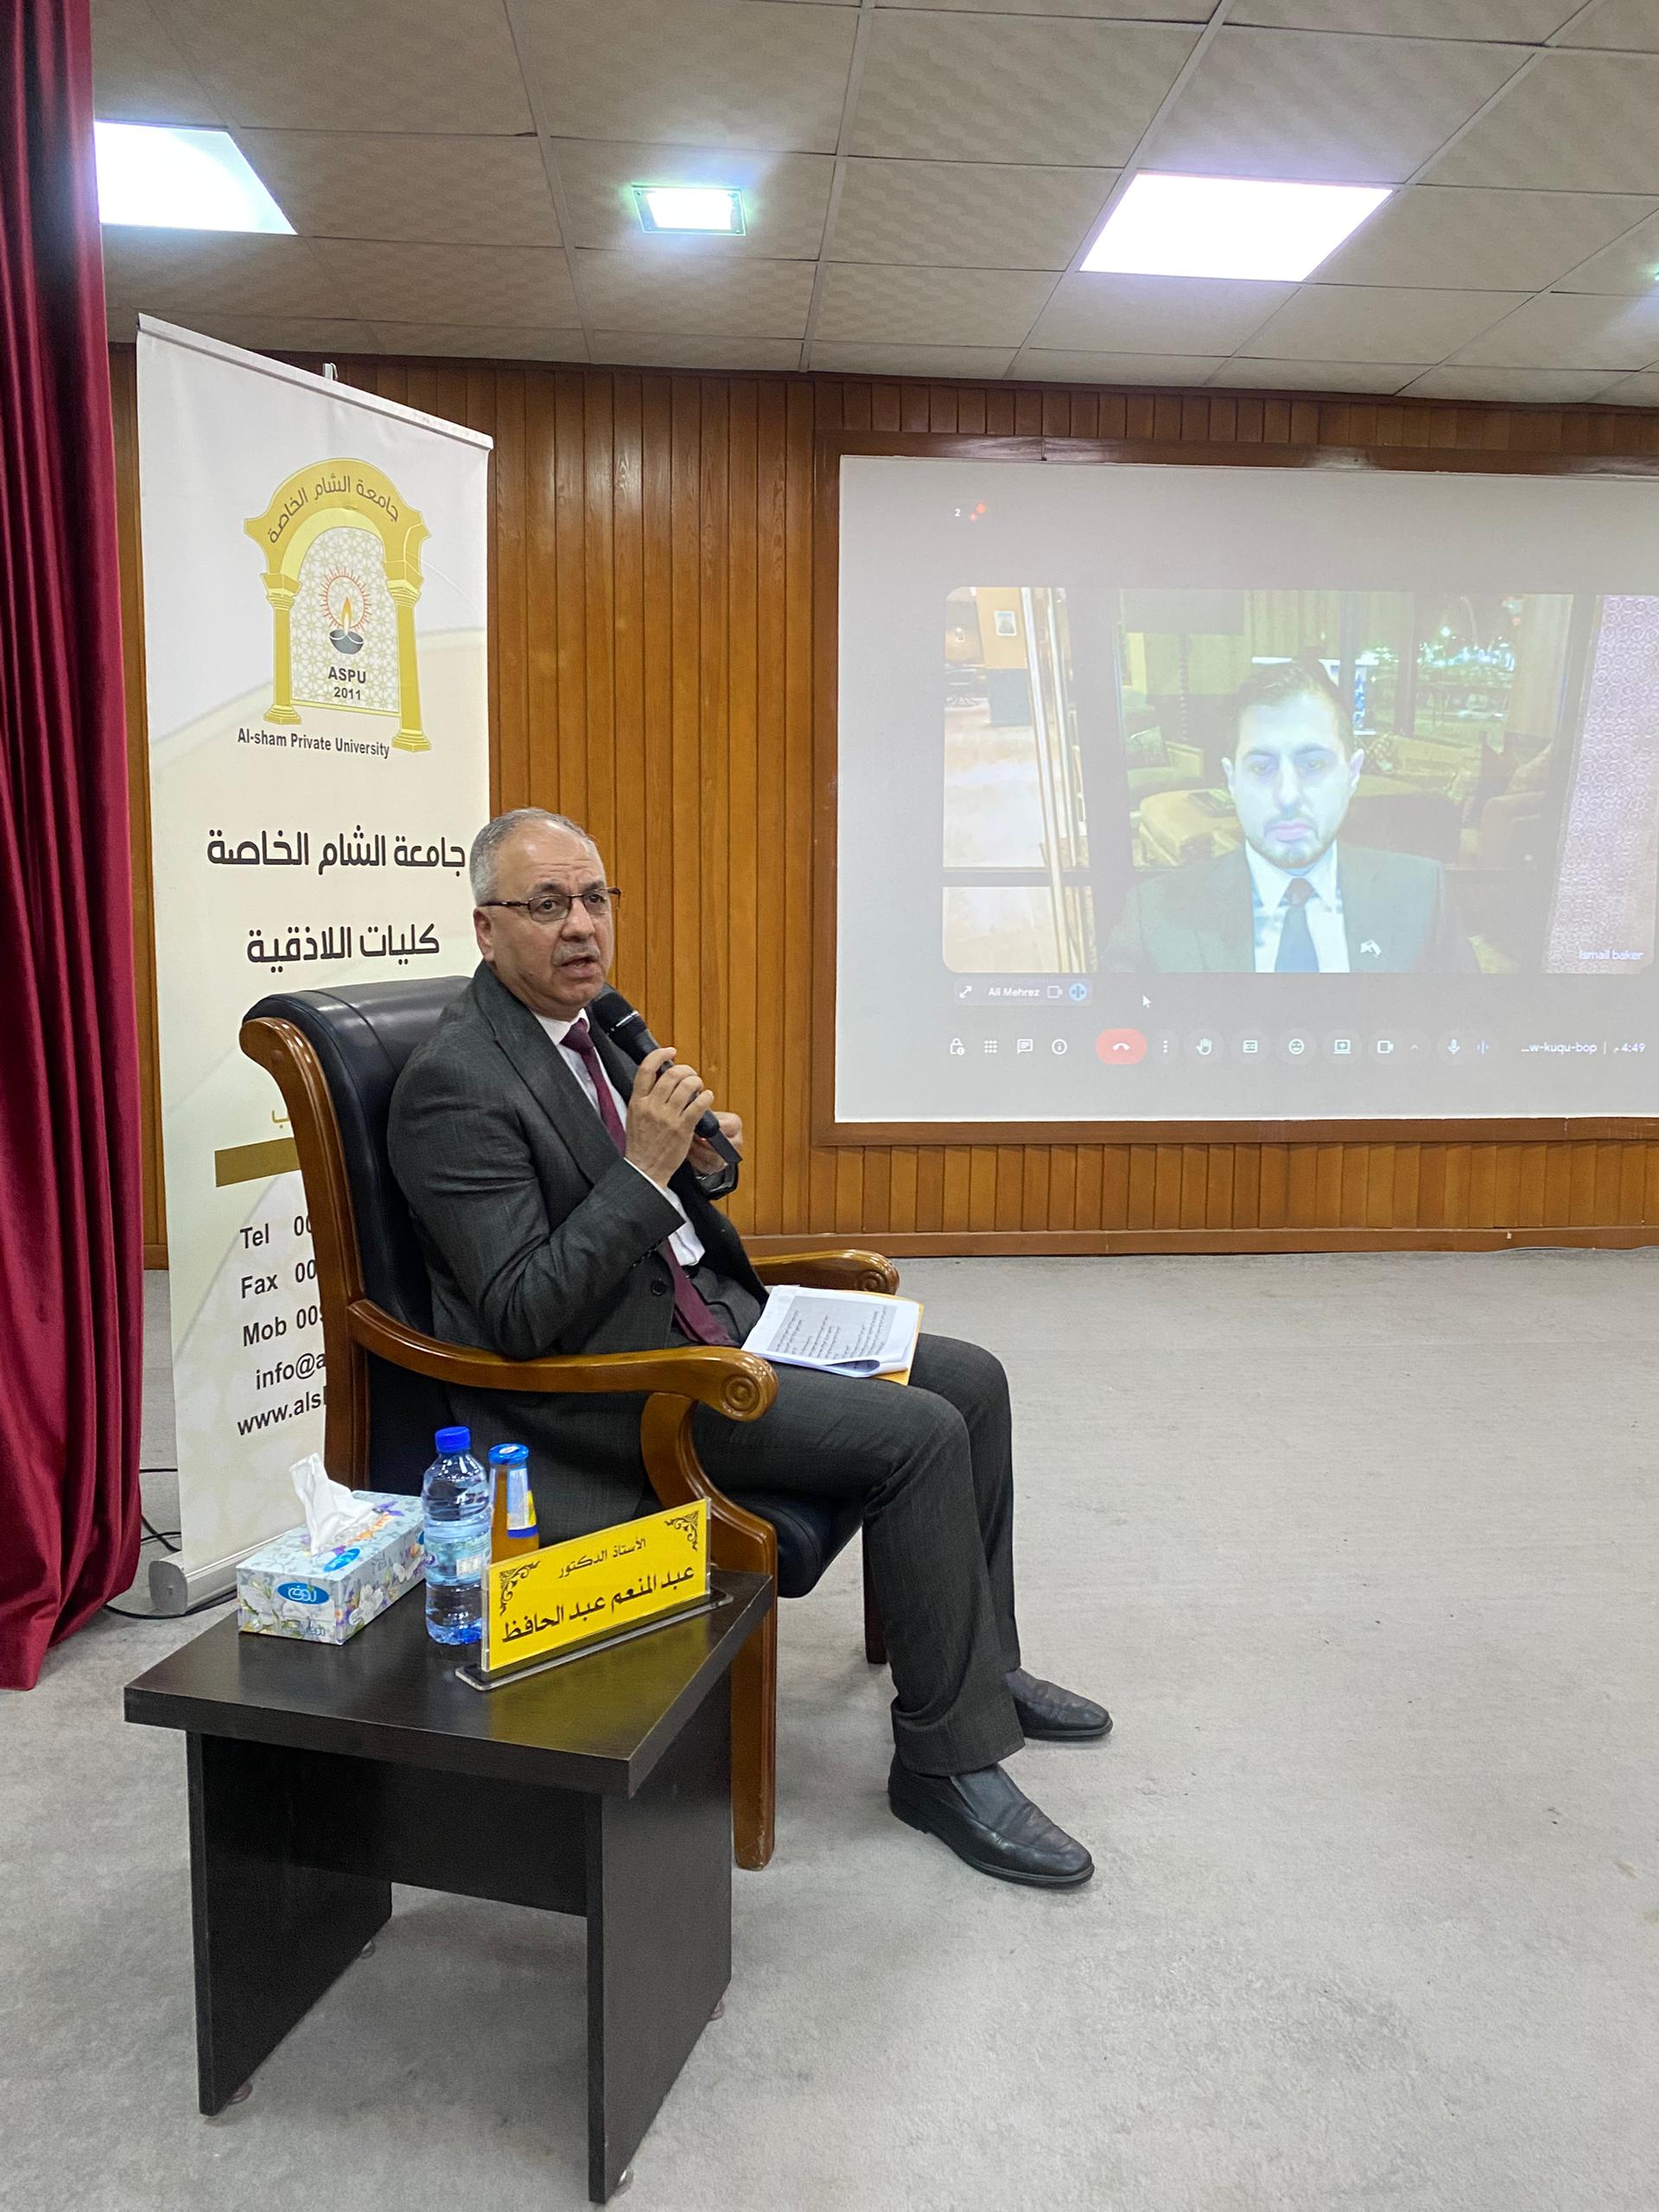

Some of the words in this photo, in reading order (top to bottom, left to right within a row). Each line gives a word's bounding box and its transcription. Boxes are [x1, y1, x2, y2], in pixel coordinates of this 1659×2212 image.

[314, 473, 351, 500] الشام
[268, 487, 308, 543] الخاصة
[356, 480, 398, 523] جامعة
[954, 508, 961, 517] 2
[327, 666, 366, 684] ASPU
[334, 686, 361, 701] 2011
[238, 728, 287, 748] Al-sham
[290, 733, 332, 751] Private
[335, 737, 390, 760] University
[207, 830, 309, 866] الخاصة
[318, 824, 385, 875] الشام
[394, 836, 466, 877] جامعة
[247, 925, 352, 973] اللاذقية
[359, 923, 440, 965] كليات
[1611, 950, 1643, 960] baker
[988, 987, 1001, 996] Ali
[1003, 987, 1040, 996] Mehrez
[1621, 1042, 1646, 1052] 4:49
[239, 1223, 270, 1249] Tel
[241, 1274, 278, 1300] Fax
[243, 1316, 287, 1347] Mob
[296, 1305, 323, 1330] 00
[612, 1536, 646, 1558] الأستاذ
[558, 1549, 607, 1579] الدكتور
[611, 1573, 657, 1613] المنعم
[661, 1567, 695, 1591] عبد
[569, 1597, 605, 1621] عبد
[501, 1604, 564, 1643] الحافظ
